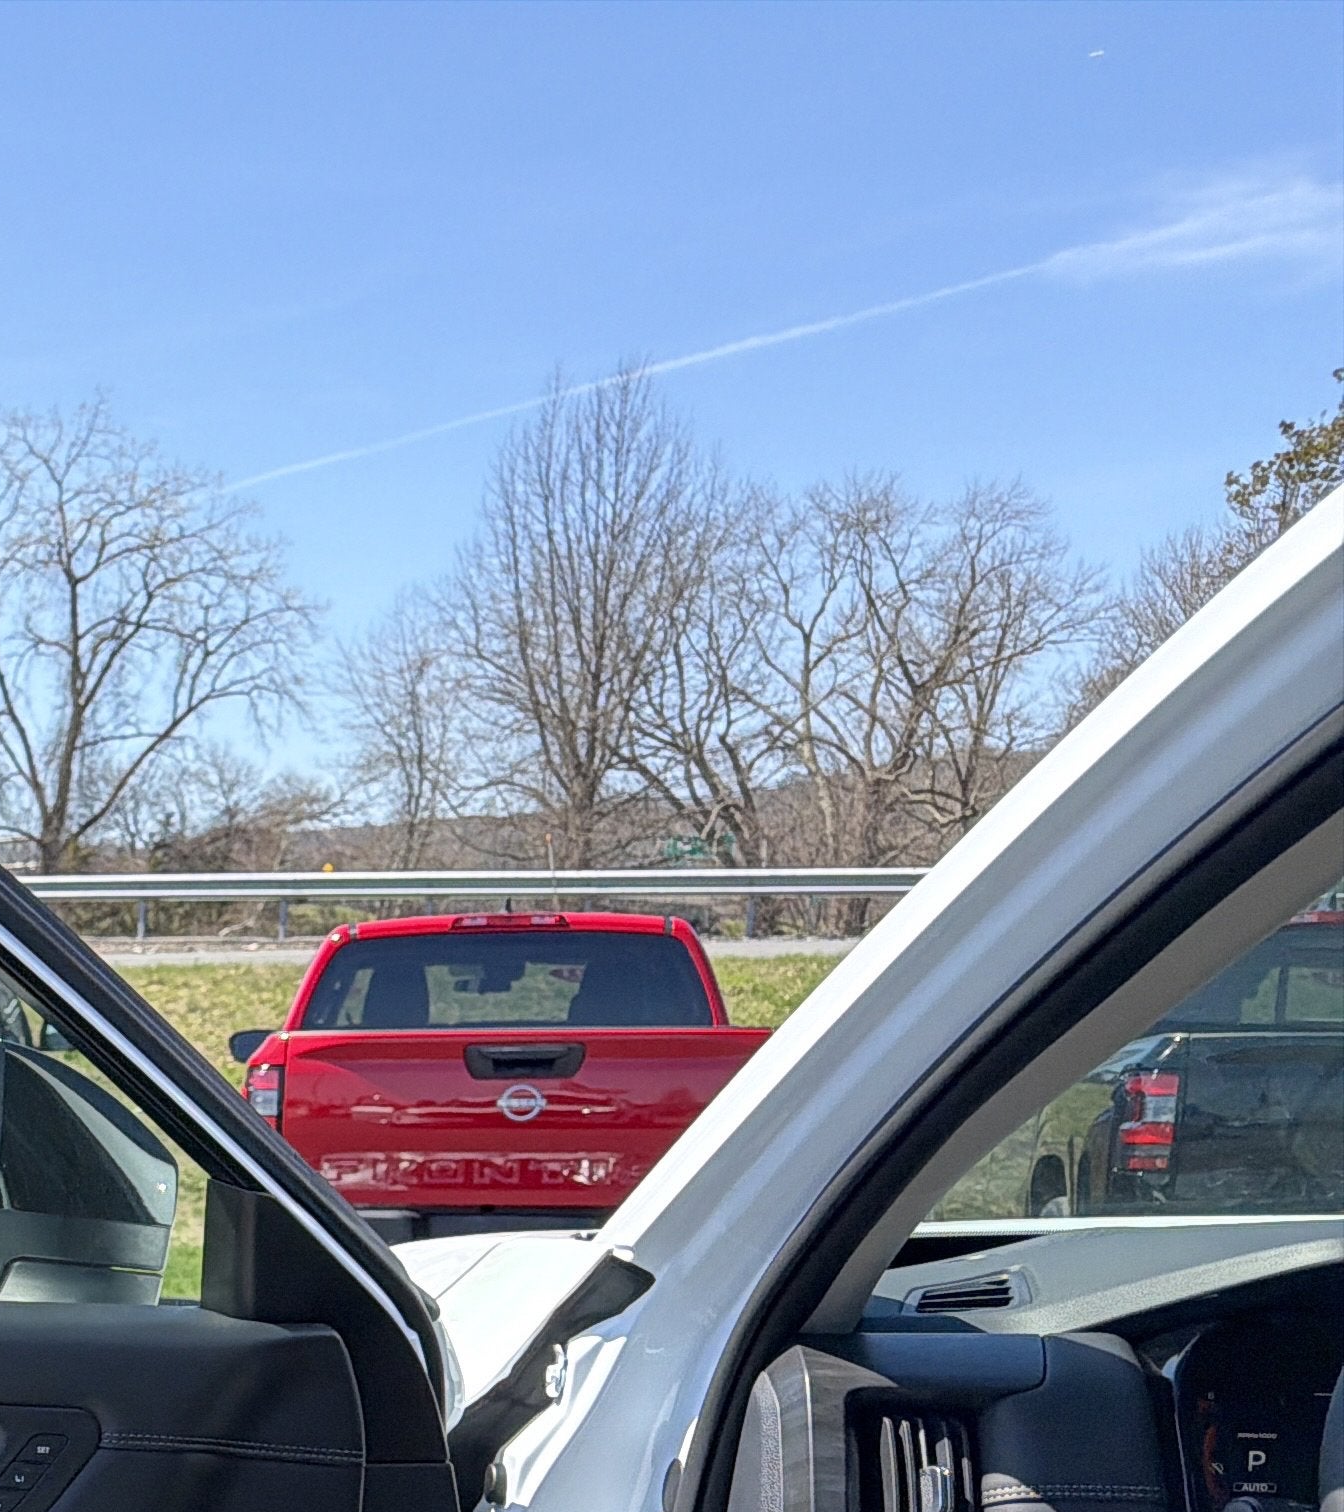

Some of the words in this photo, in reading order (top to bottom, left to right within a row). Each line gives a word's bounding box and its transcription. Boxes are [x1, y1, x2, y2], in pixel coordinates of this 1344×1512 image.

[36, 1446, 50, 1454] SET
[1247, 1450, 1266, 1472] P
[1241, 1482, 1268, 1492] AUTO
